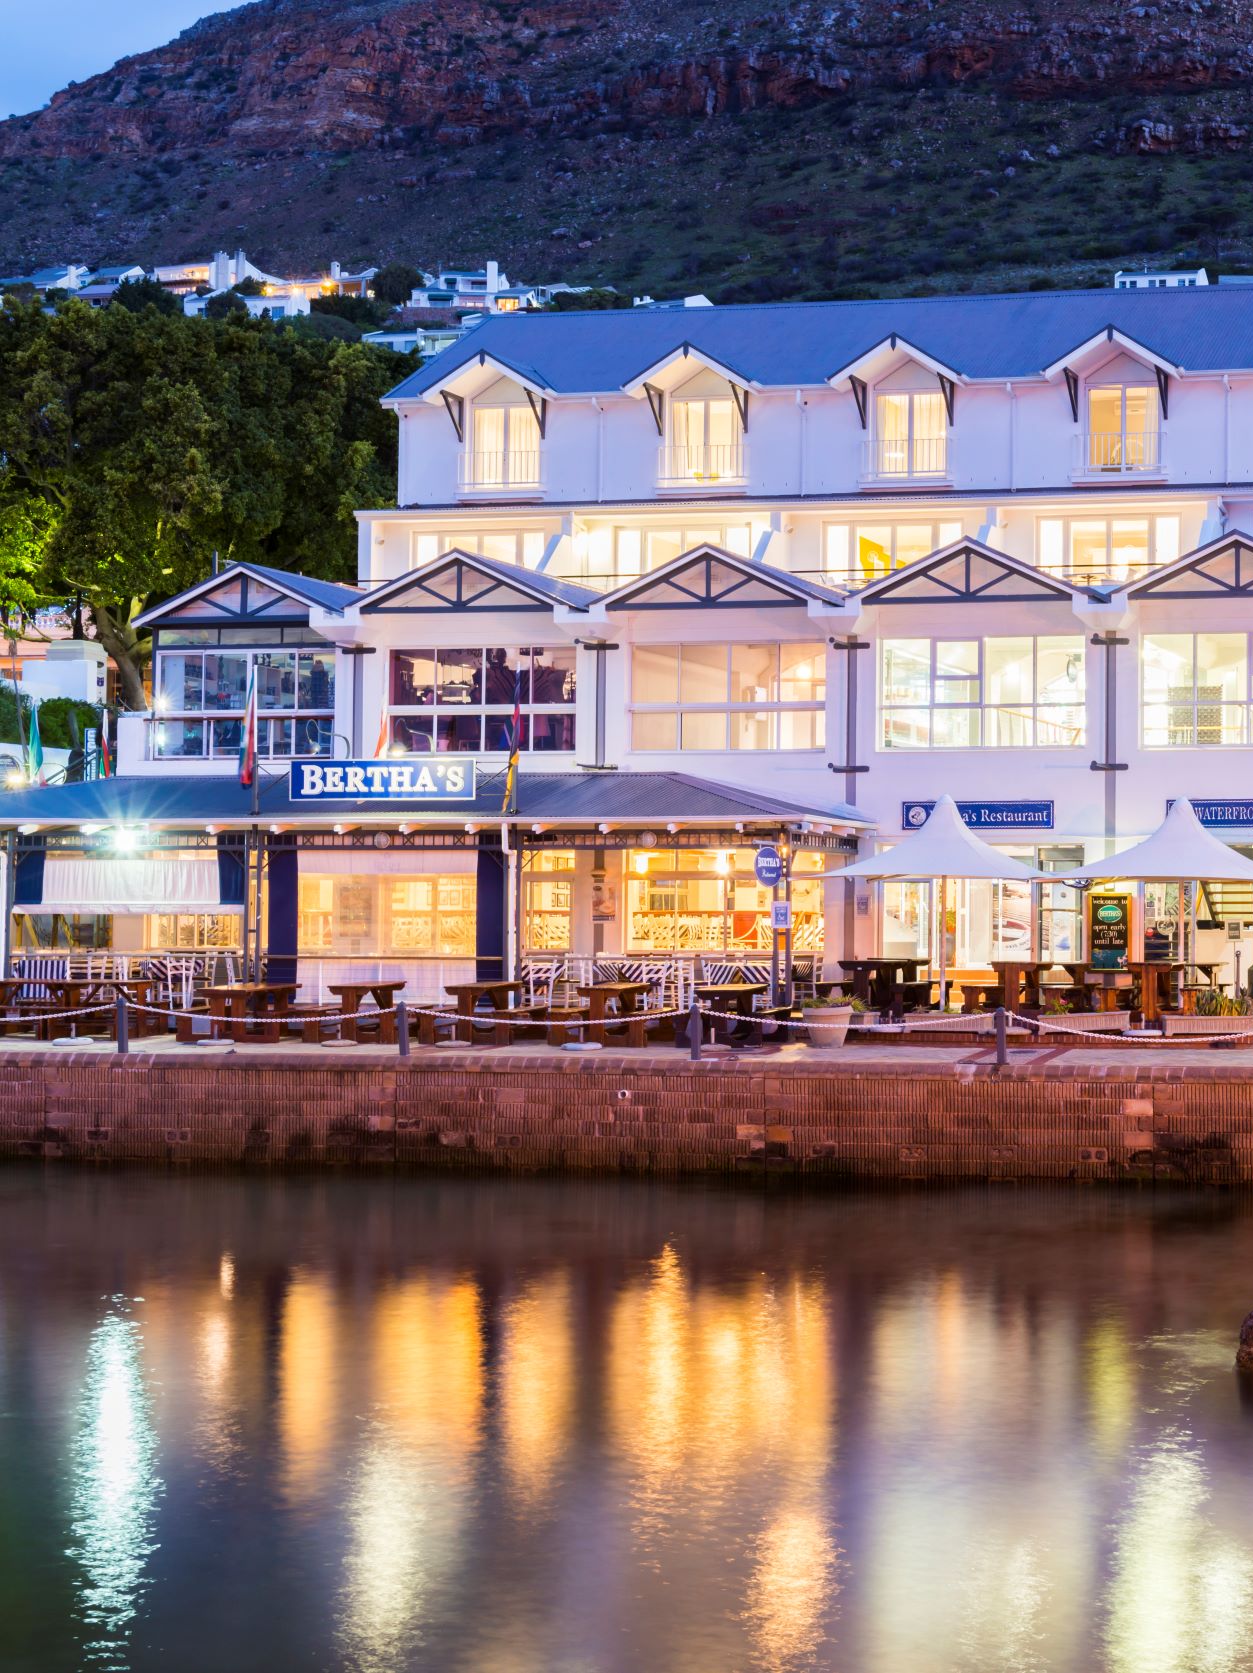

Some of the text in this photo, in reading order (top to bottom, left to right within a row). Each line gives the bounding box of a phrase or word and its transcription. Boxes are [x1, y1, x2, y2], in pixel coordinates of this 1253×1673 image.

[301, 764, 465, 796] BERTHA'S
[980, 809, 1049, 822] Restaurant
[1110, 924, 1126, 932] early
